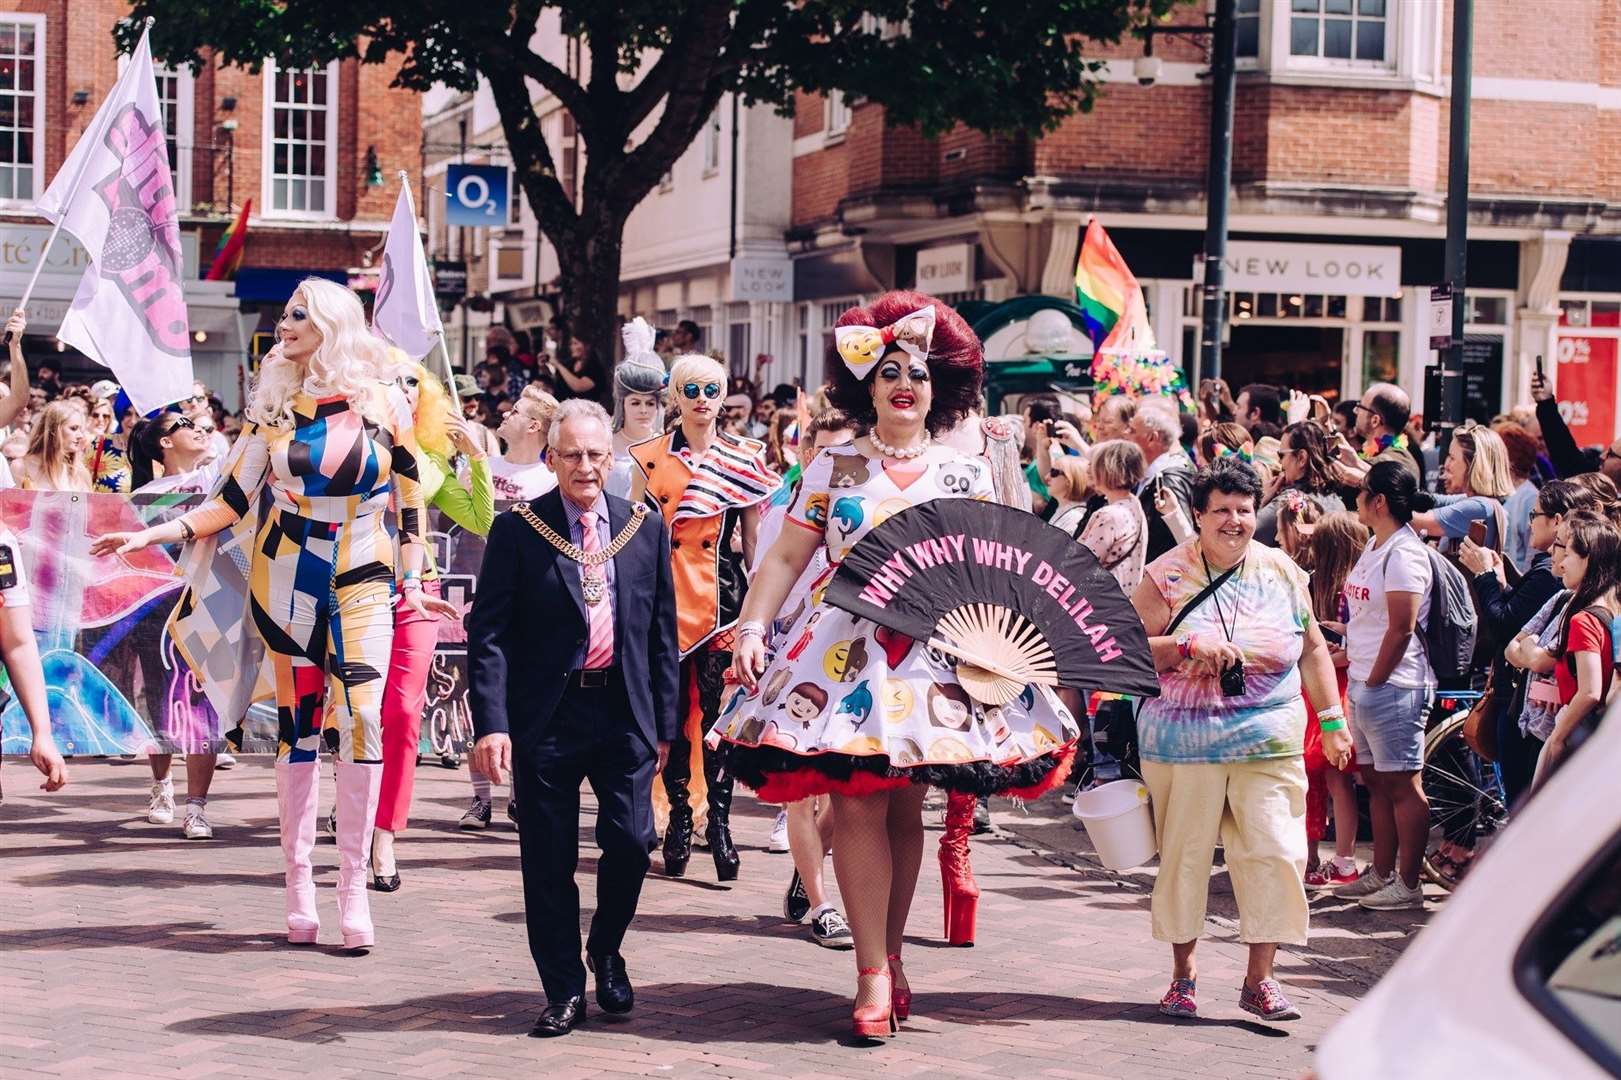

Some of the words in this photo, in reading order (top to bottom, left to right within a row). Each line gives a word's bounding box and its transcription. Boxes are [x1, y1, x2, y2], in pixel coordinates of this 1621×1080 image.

[743, 267, 784, 280] NEW
[1225, 257, 1289, 275] NEW
[1305, 260, 1384, 279] LOOK
[740, 281, 785, 293] LOOK
[859, 550, 914, 609] WHY
[905, 534, 966, 571] WHY
[972, 537, 1033, 575] WHY
[1031, 560, 1123, 663] DELILAH
